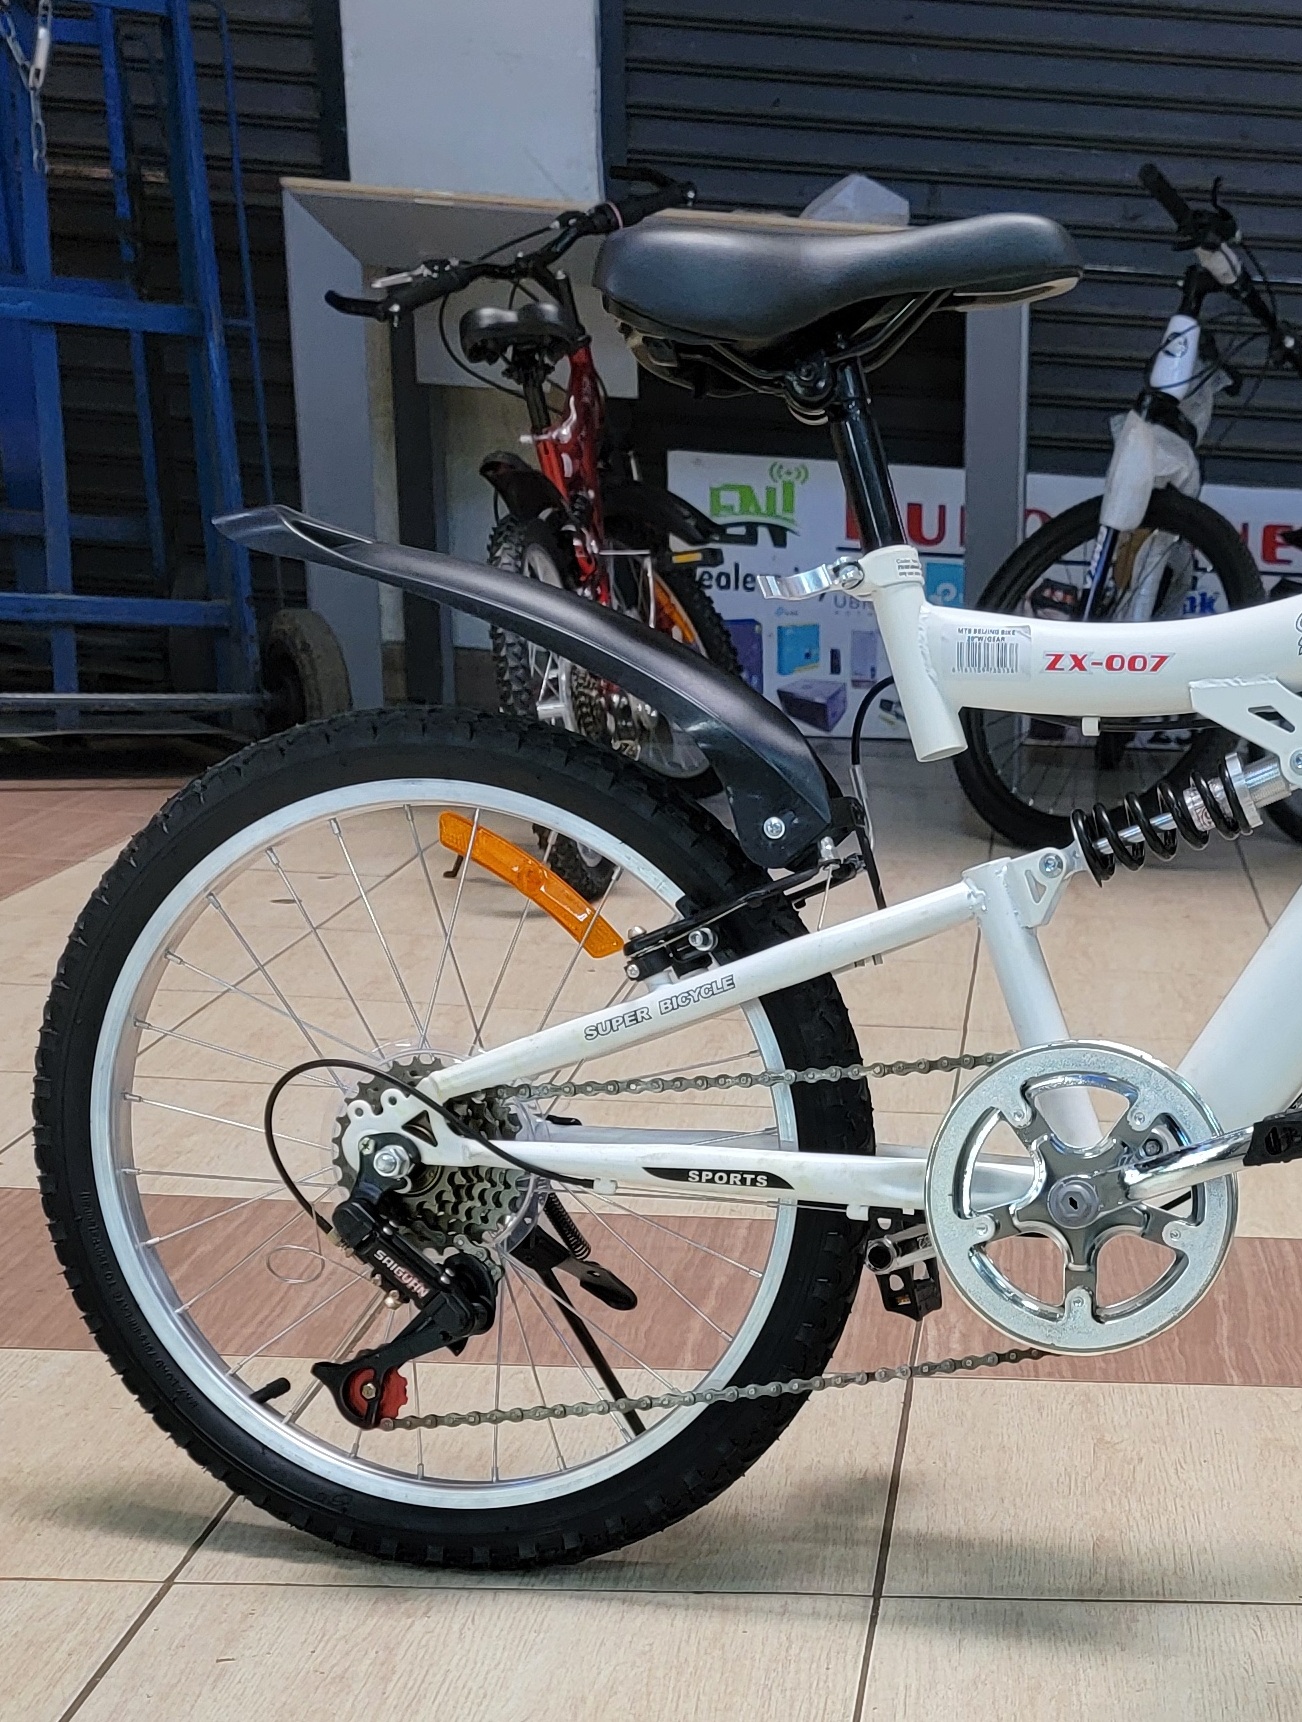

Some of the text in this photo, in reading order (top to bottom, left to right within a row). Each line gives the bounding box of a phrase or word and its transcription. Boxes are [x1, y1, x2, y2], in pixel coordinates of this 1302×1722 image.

[1044, 653, 1170, 672] ZX-007
[584, 974, 736, 1040] SUPER BICYCLE
[687, 1169, 769, 1188] SPORTS
[373, 1248, 431, 1299] SAIGUAN
